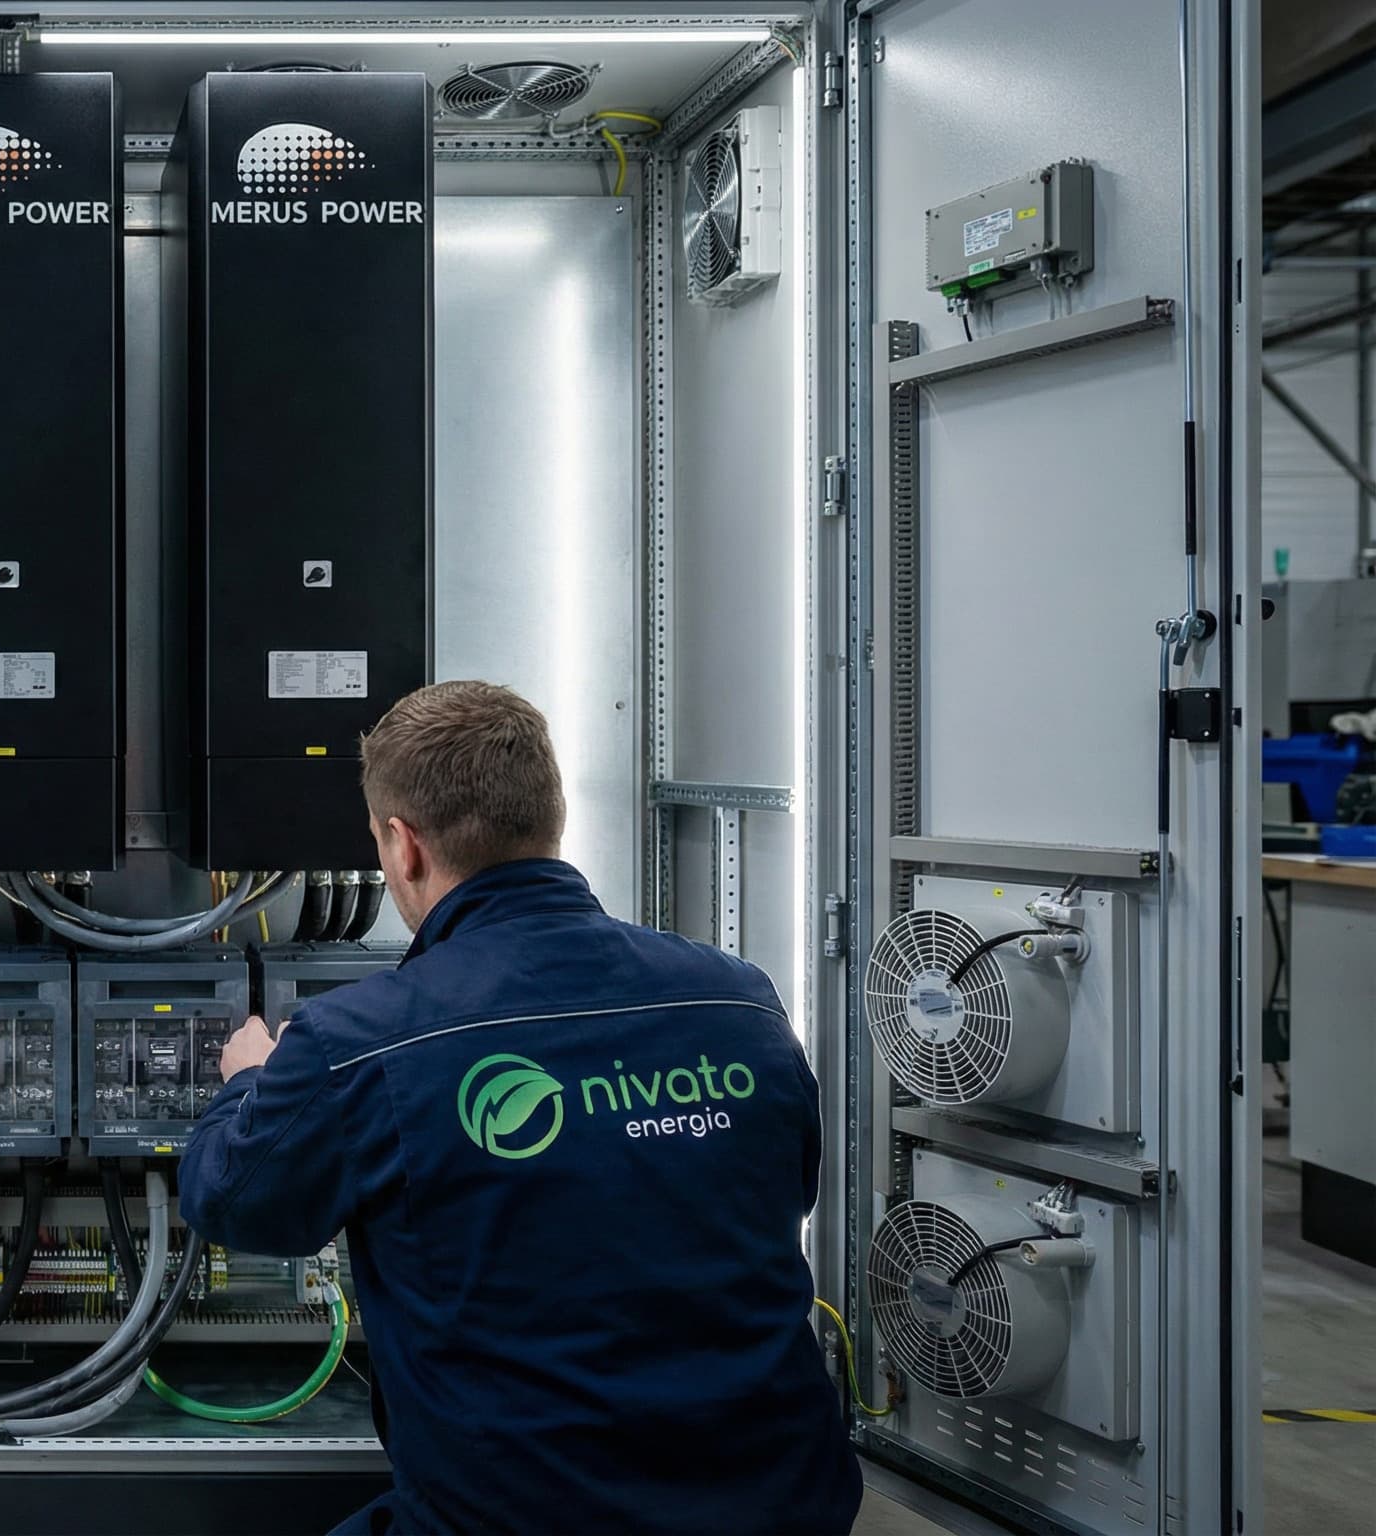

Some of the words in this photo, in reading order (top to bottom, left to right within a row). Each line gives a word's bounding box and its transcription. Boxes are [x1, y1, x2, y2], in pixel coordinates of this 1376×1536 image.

[8, 202, 110, 224] POWER
[211, 201, 308, 224] MERUS
[321, 201, 424, 224] POWER
[580, 1054, 755, 1115] nivato
[625, 1106, 731, 1138] energia
